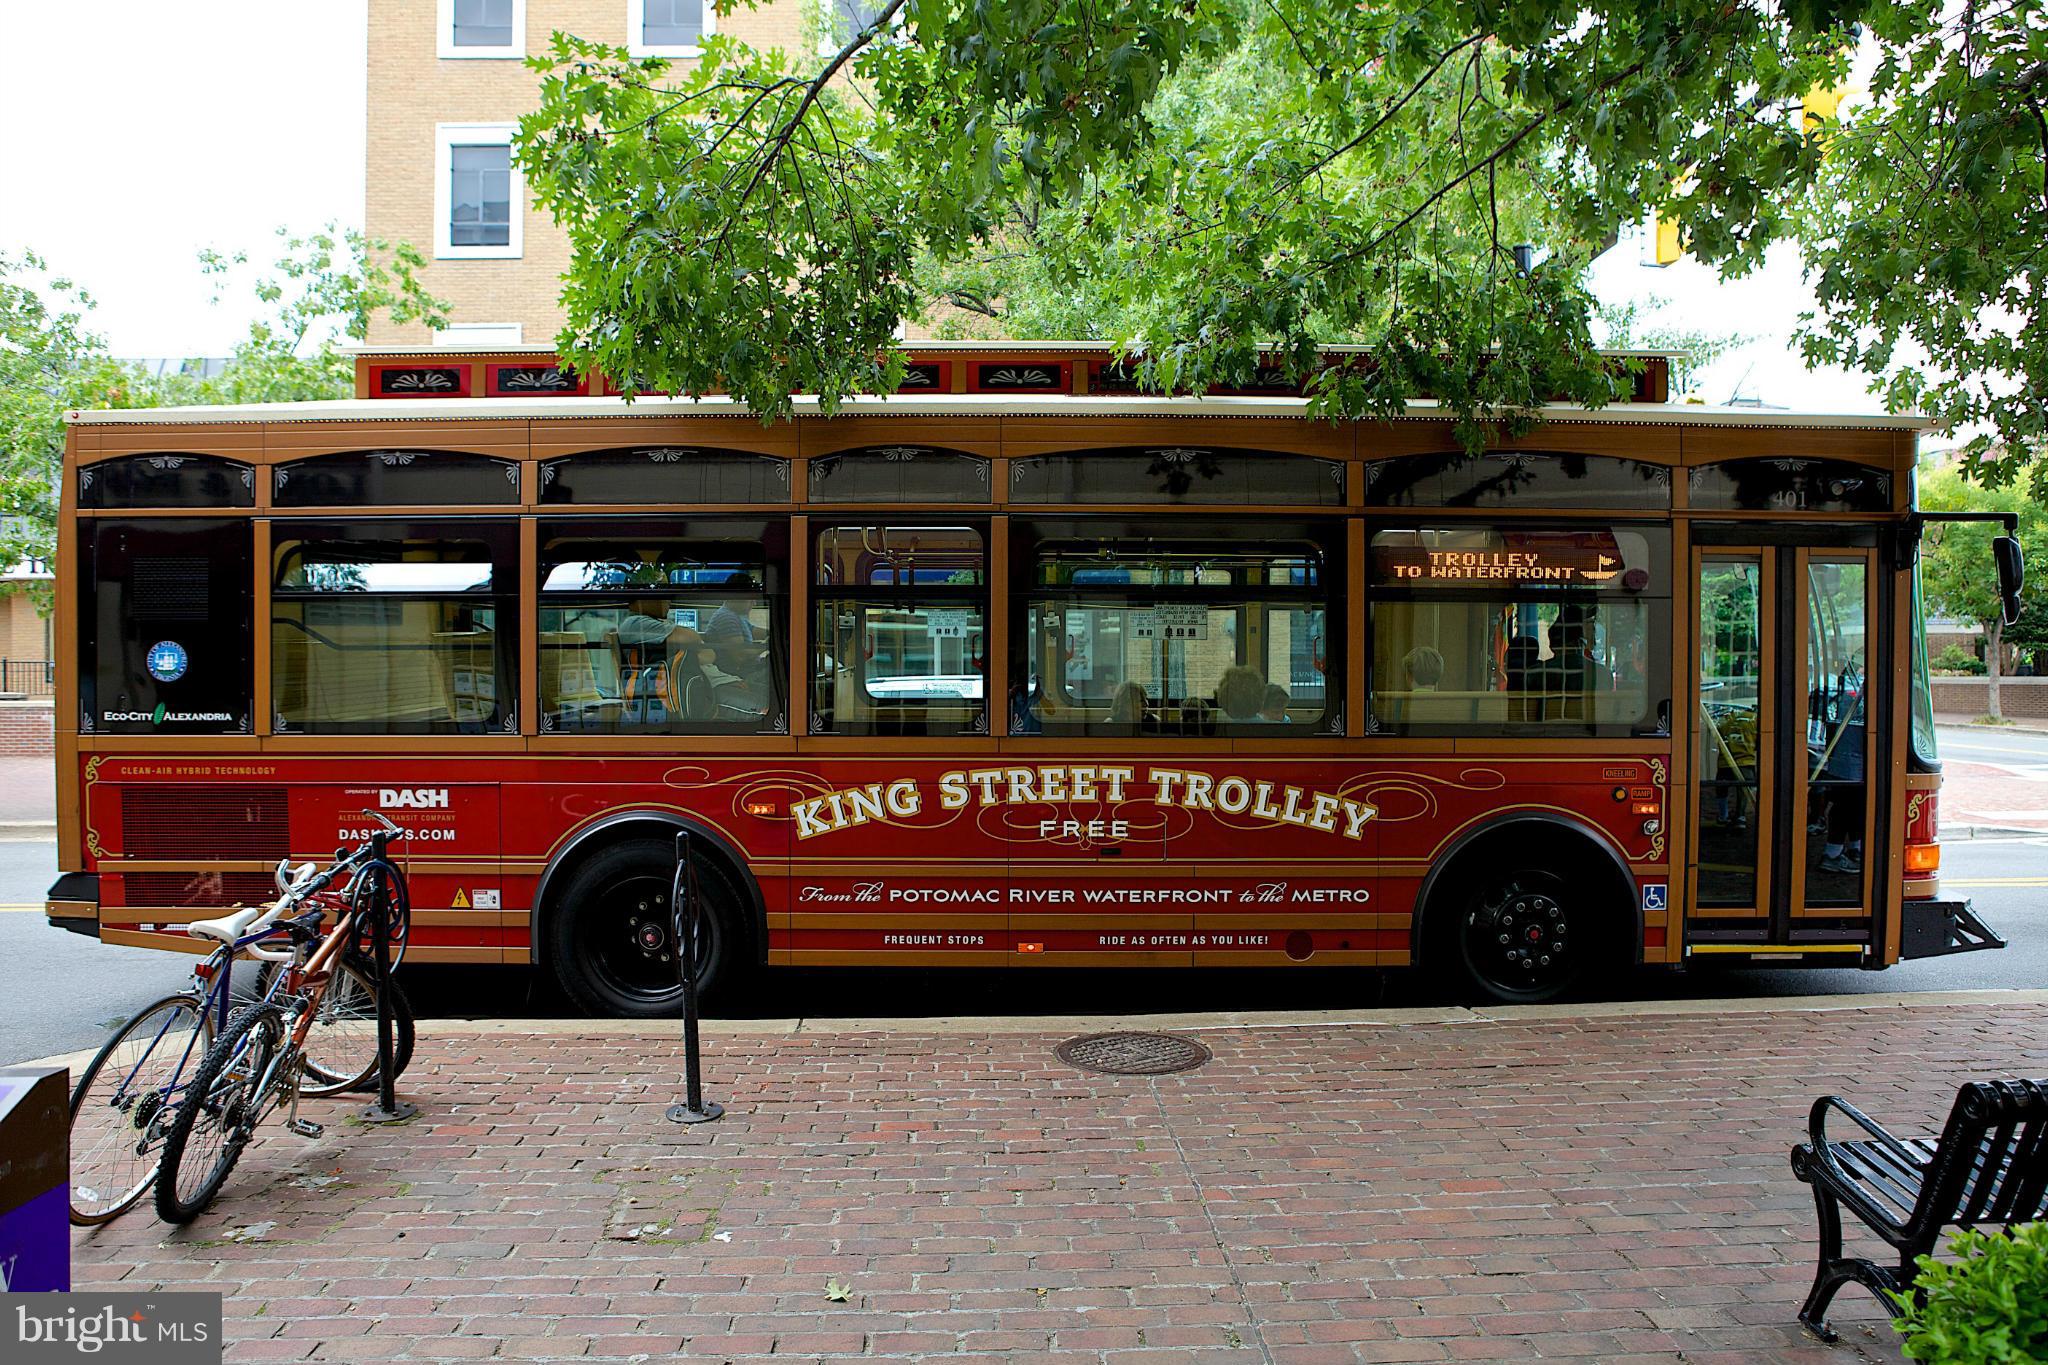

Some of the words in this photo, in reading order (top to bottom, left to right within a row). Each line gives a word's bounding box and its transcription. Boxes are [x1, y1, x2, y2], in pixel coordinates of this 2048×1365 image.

[1774, 490, 1807, 507] 401
[1429, 552, 1538, 567] TROLLEY
[1393, 565, 1422, 578] TO
[1430, 566, 1575, 580] WATERFRONT
[163, 711, 232, 721] ALEXANDRIA
[121, 766, 172, 775] CLEAN-AIR
[176, 766, 211, 775] HYBRID
[215, 766, 276, 775] TECHNOLOGY
[1605, 769, 1635, 777] KNEELING
[379, 789, 448, 808] DASH
[790, 778, 922, 840] KING
[939, 765, 1135, 810] STREET
[1149, 767, 1379, 840] TROLLEY
[387, 814, 417, 822] TRANSIT
[421, 814, 455, 822] COMPANY
[1040, 820, 1129, 837] FREE
[798, 886, 852, 903] From
[850, 881, 884, 903] the
[889, 889, 1000, 903] POTOMAC
[1009, 889, 1075, 903] RIVER
[1083, 889, 1233, 903] WATERFRONT
[1238, 891, 1256, 904] to
[1254, 882, 1287, 904] the
[1291, 889, 1370, 903] METRO
[884, 935, 943, 945] FREQUENT
[948, 935, 984, 945] STOPS
[1099, 936, 1126, 945] RIDE
[1131, 936, 1146, 945] AS
[1151, 936, 1186, 945] OFTEN
[1192, 936, 1206, 945] AS
[1211, 936, 1234, 945] YOU
[1238, 936, 1269, 945] LIKE!
